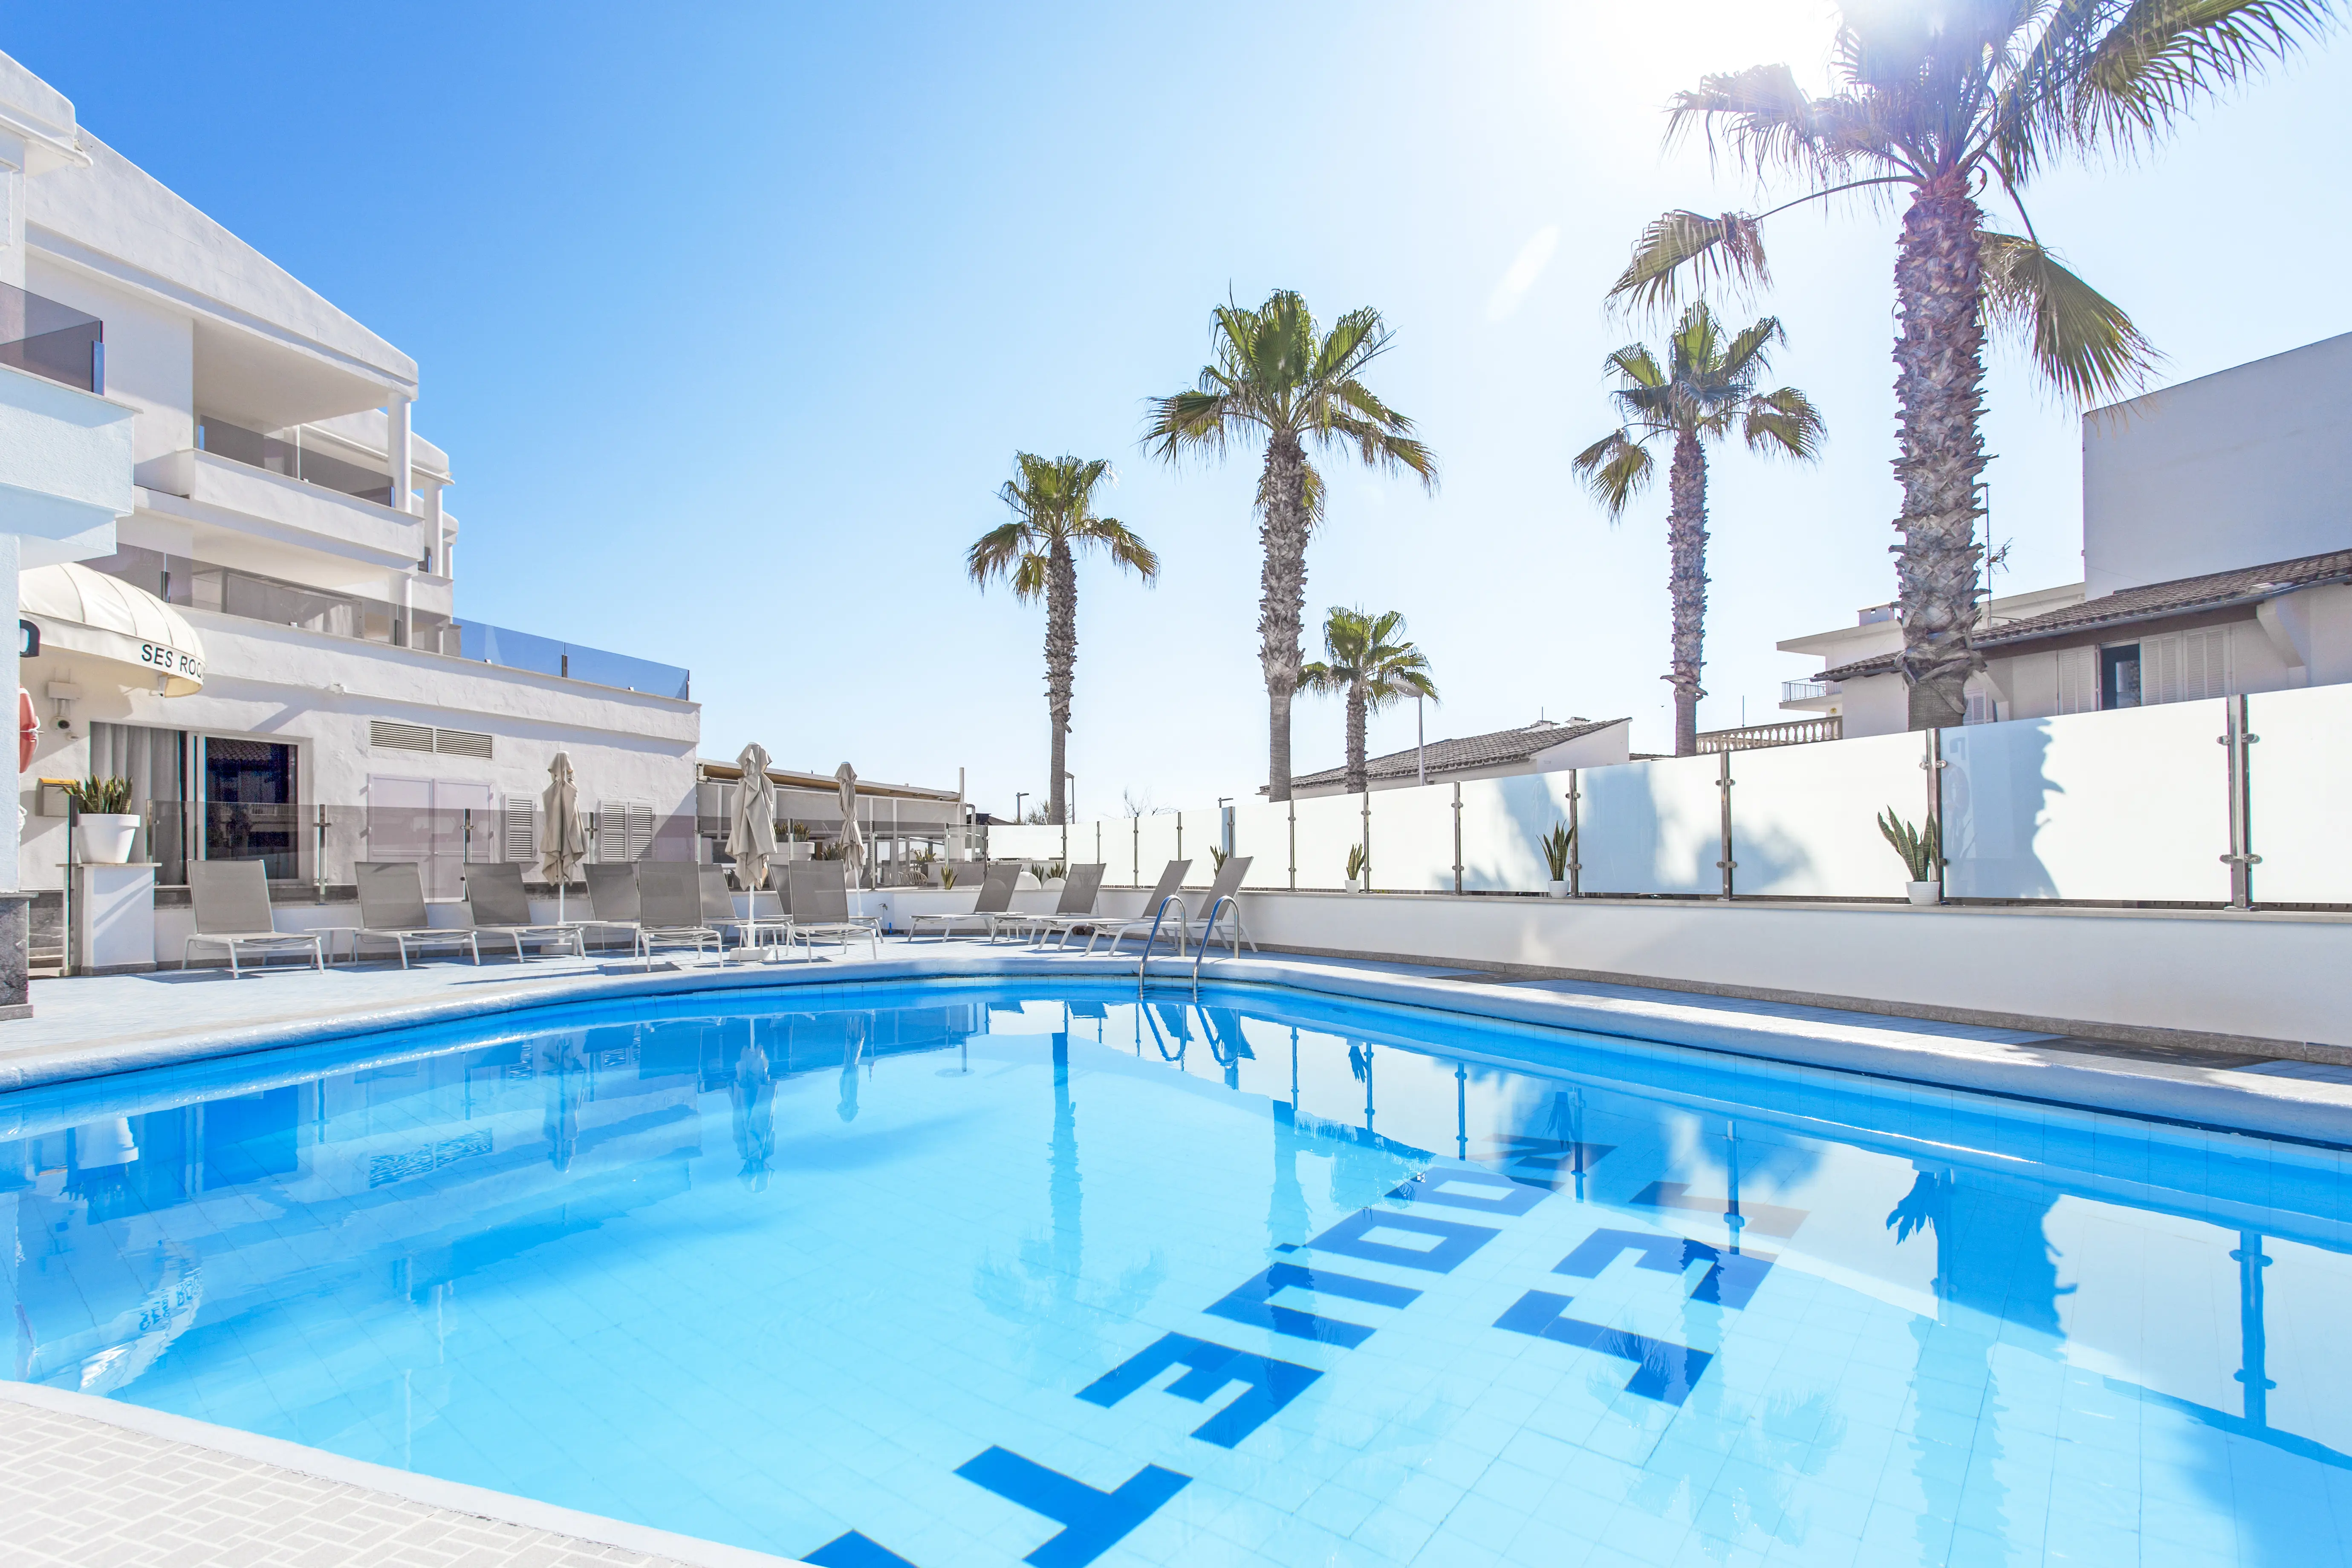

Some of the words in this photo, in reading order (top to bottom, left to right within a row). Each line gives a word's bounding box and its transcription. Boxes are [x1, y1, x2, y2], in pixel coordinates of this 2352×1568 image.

[142, 644, 173, 668] SES
[180, 655, 205, 682] ROQ
[798, 1133, 1618, 1568] ROQUET
[1491, 1181, 1811, 1407] SES
